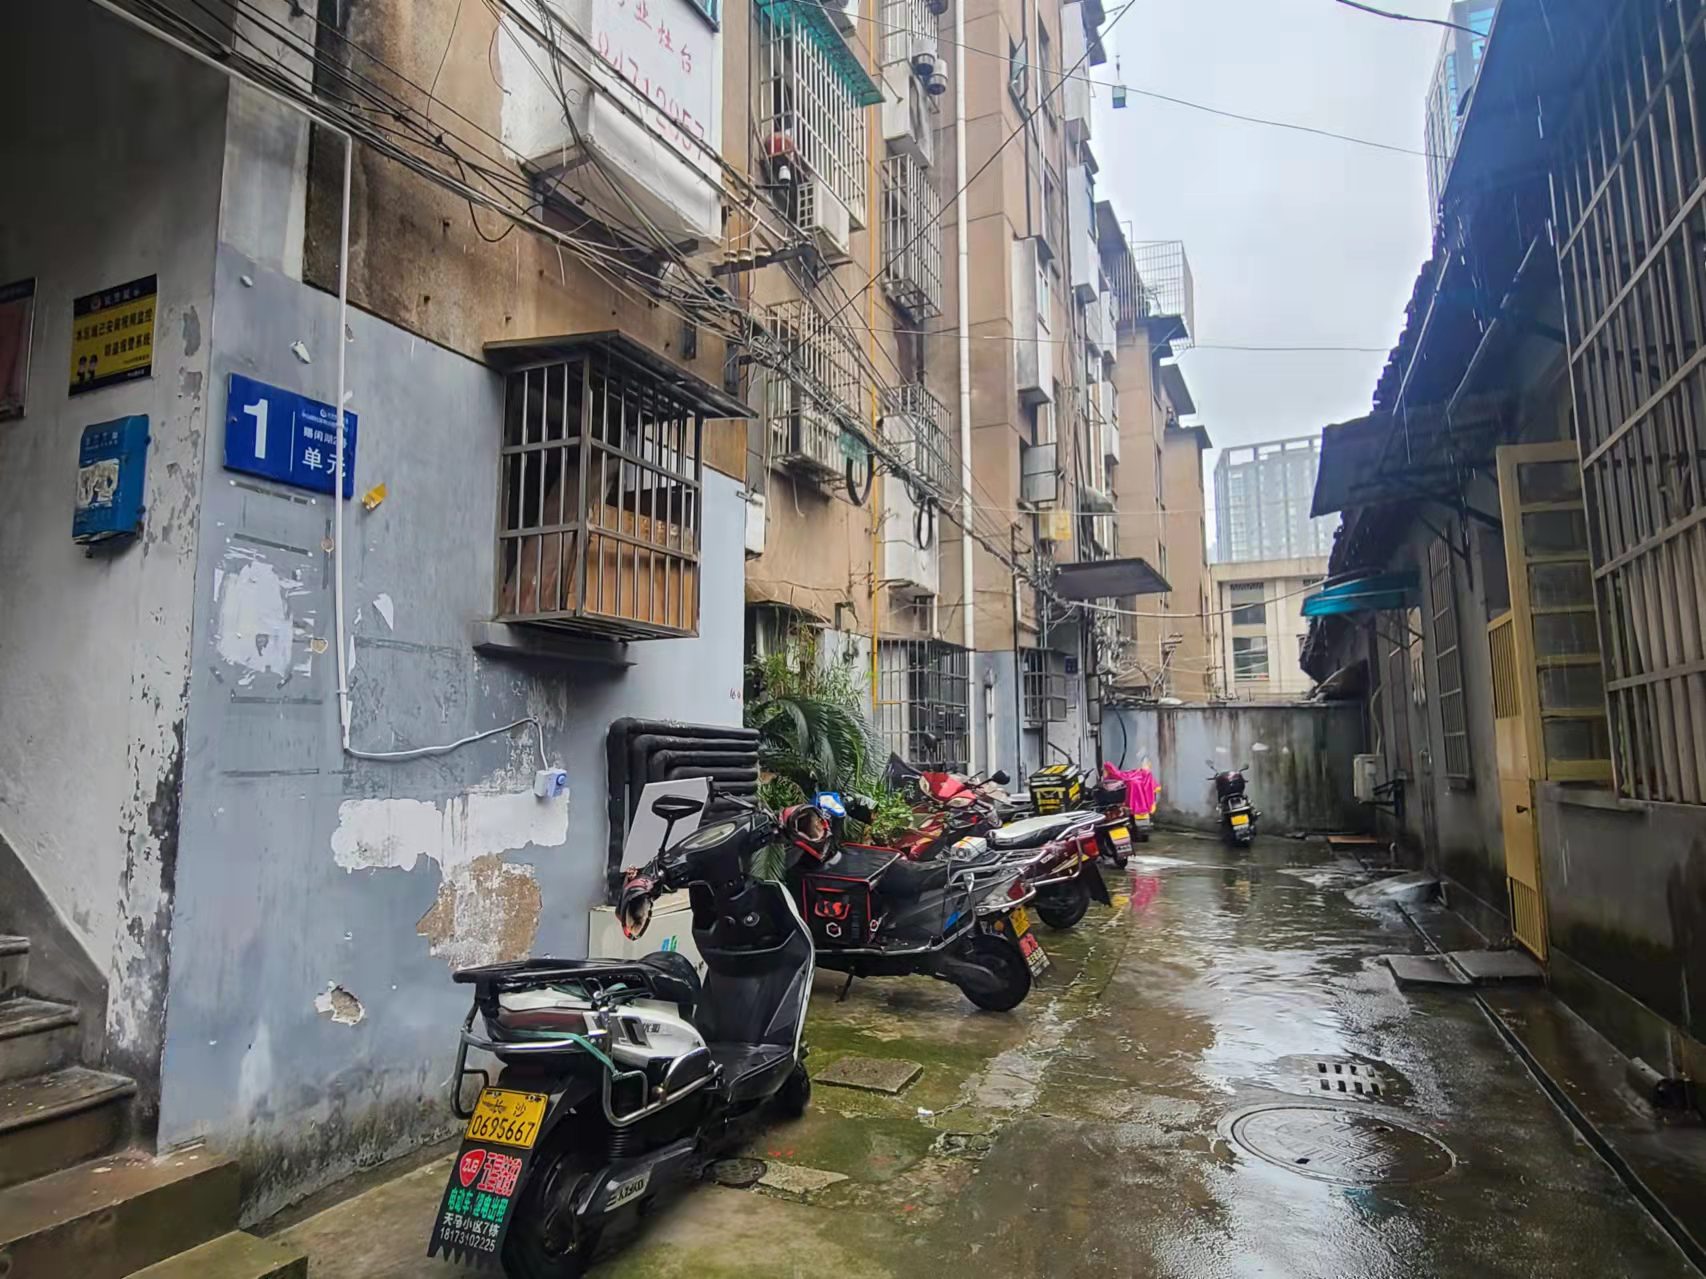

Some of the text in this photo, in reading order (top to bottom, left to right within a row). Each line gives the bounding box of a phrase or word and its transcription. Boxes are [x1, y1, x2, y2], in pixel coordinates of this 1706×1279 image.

[243, 398, 269, 460] 1
[302, 446, 346, 478] 单元
[471, 1114, 536, 1143] 0695667
[443, 1211, 501, 1238] 天马小区7栋
[439, 1226, 496, 1253] 18173102225
